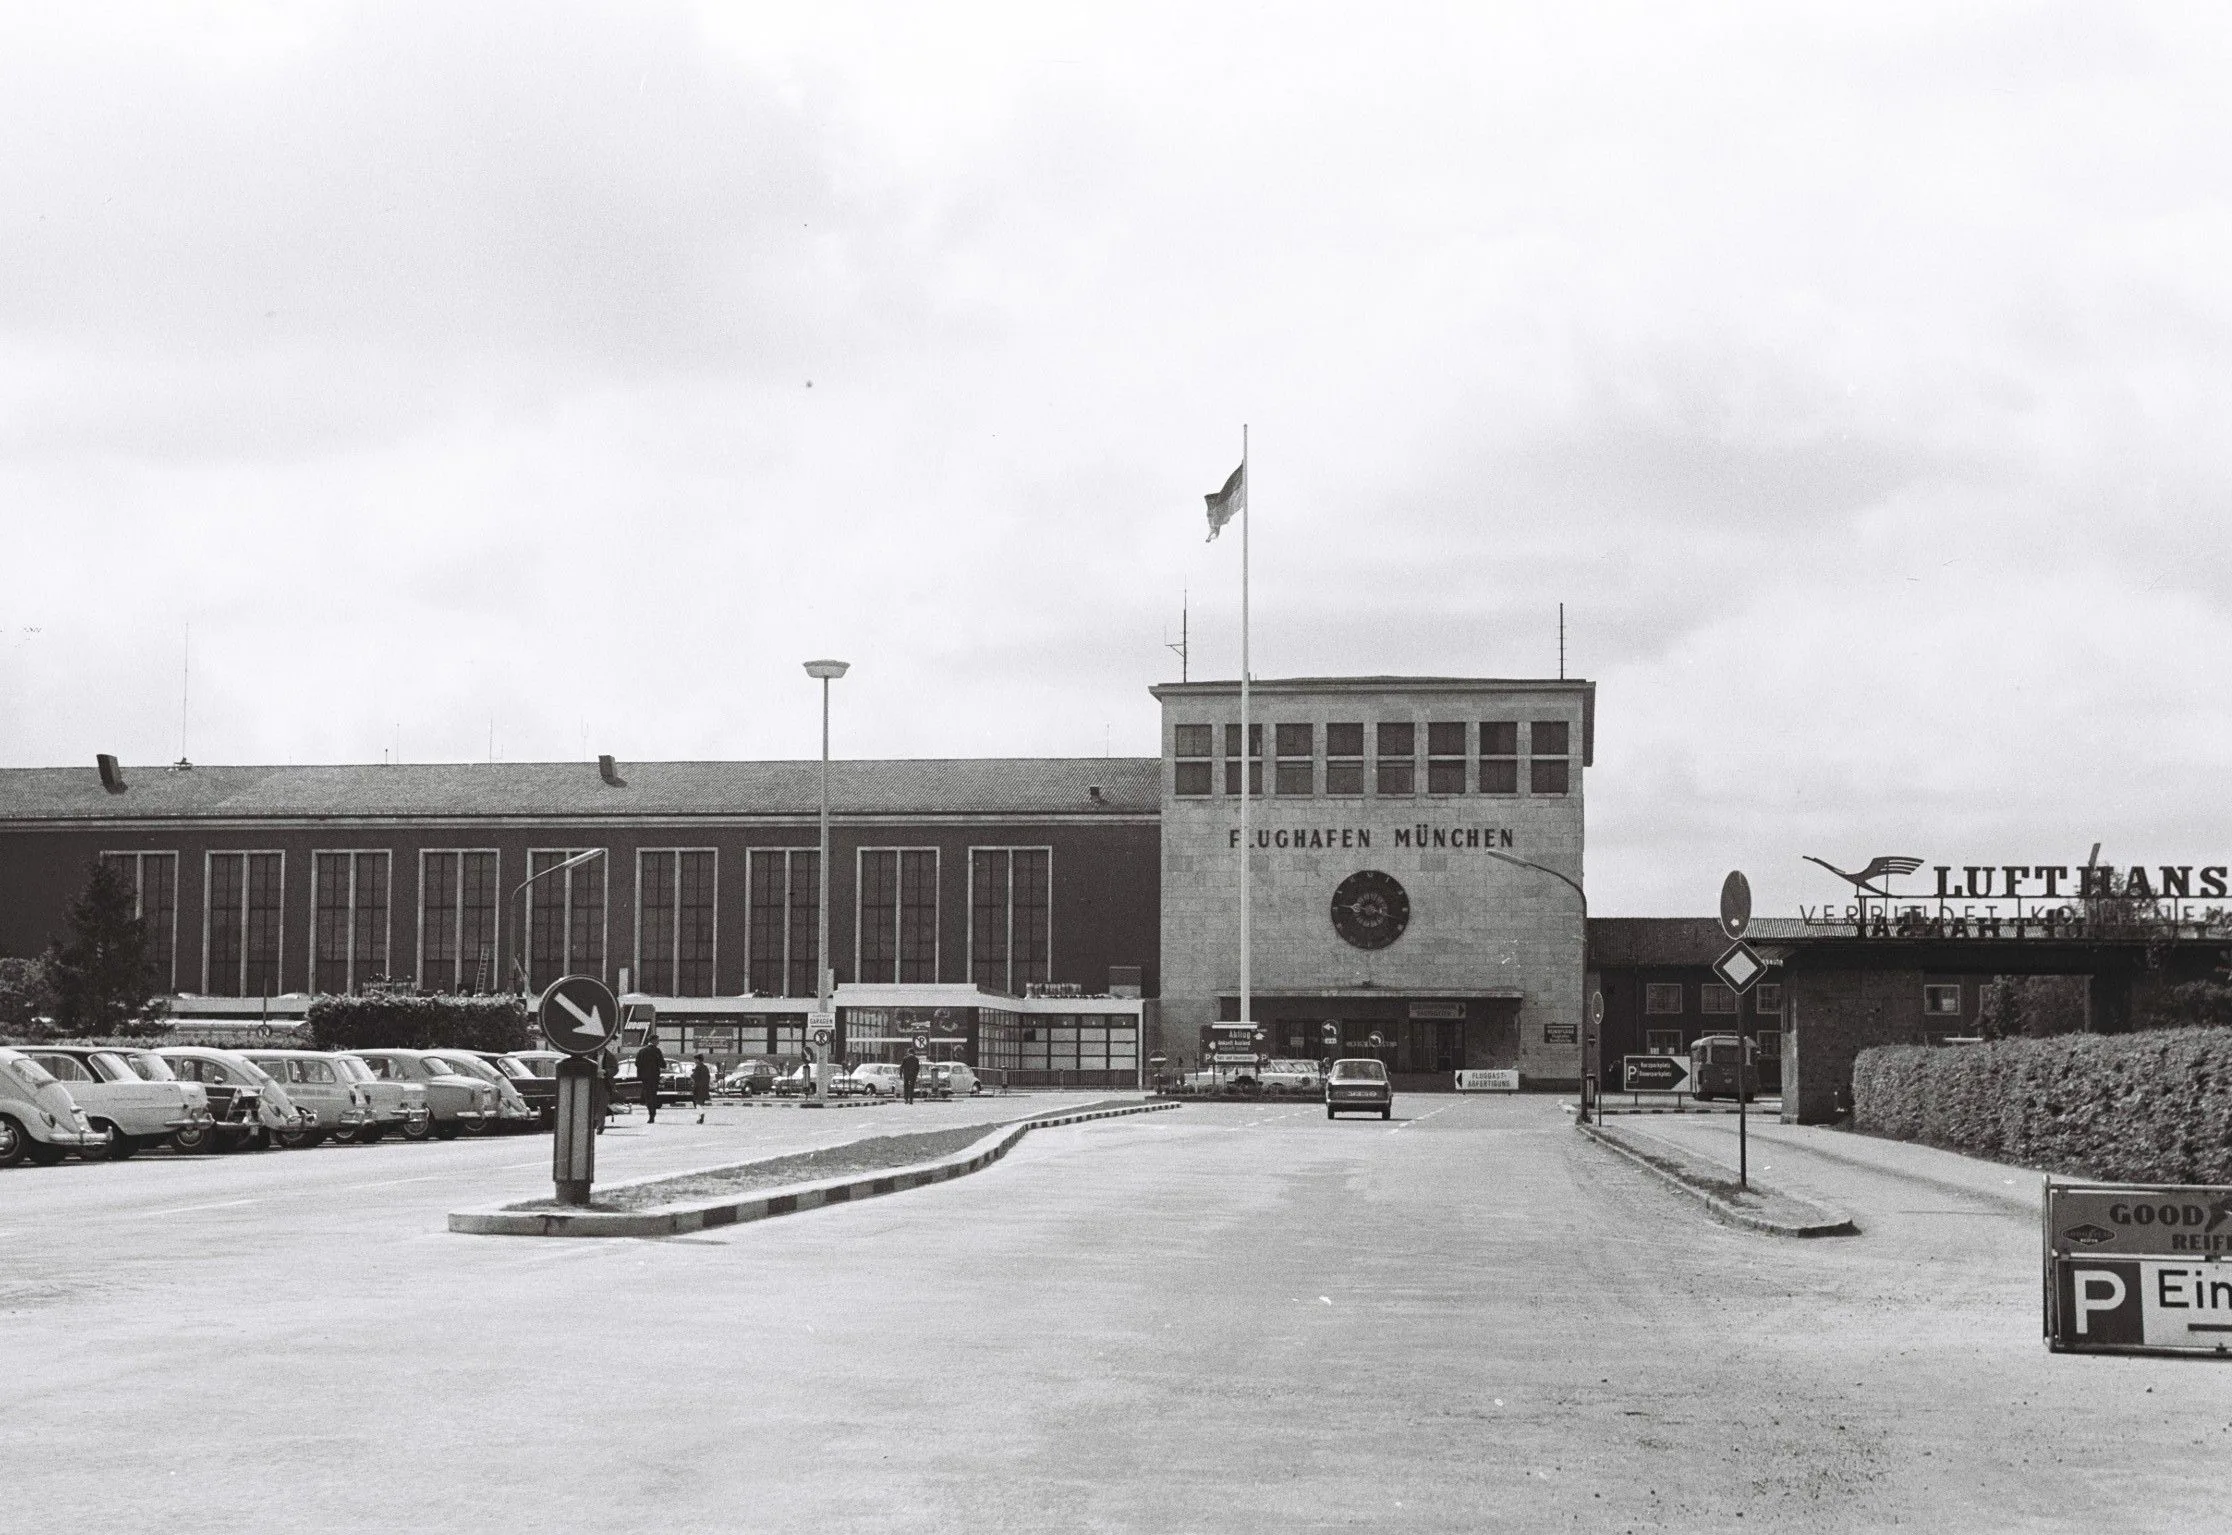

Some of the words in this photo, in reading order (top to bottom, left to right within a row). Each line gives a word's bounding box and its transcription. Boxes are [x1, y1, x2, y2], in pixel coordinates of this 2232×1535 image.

[1229, 828, 1371, 849] FUGHAFEN
[1395, 824, 1513, 849] MÜNCHEN
[1934, 866, 2228, 898] LUFTHANS
[1628, 1065, 1637, 1080] P
[2109, 1203, 2204, 1226] GOOD
[2074, 1270, 2126, 1334] P
[2158, 1269, 2232, 1309] Ein
